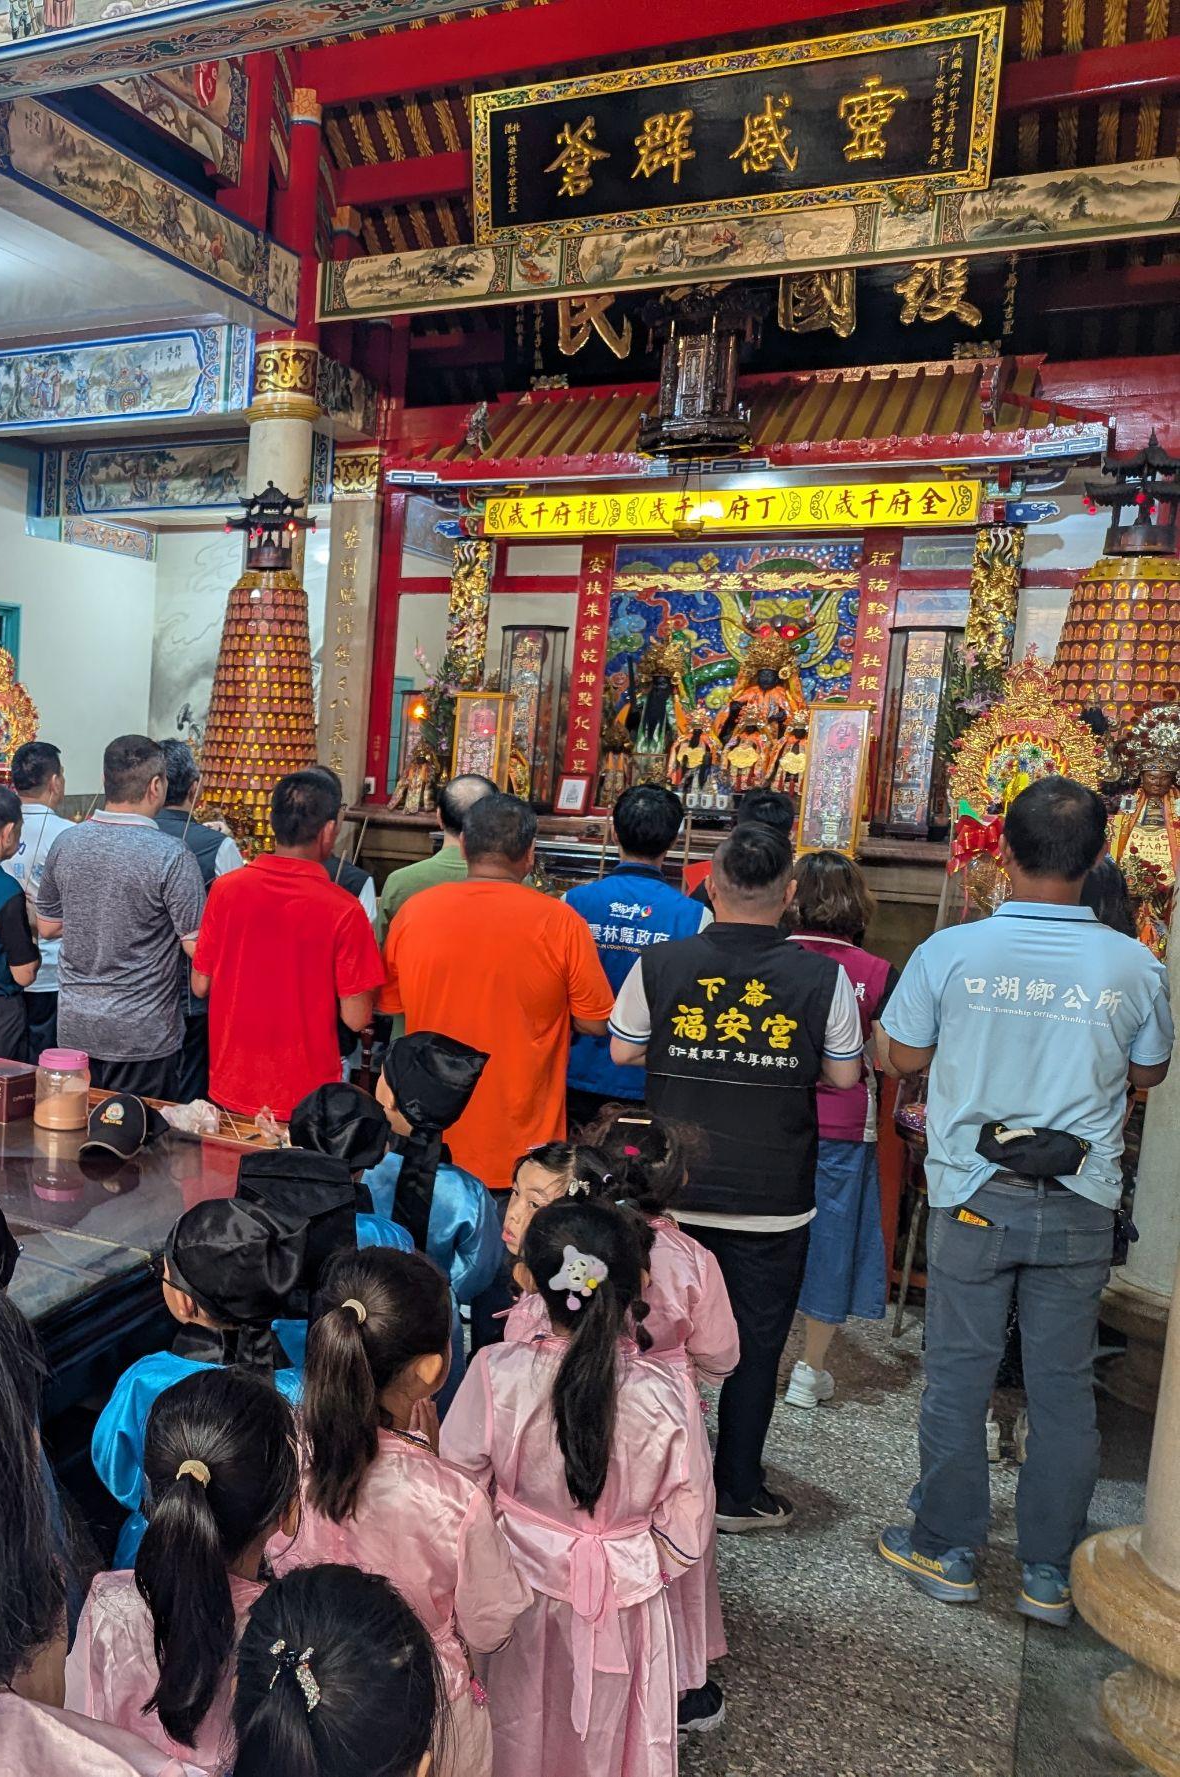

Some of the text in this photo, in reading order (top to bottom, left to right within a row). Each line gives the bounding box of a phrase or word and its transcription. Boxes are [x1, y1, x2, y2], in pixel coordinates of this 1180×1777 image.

[833, 486, 947, 519] 金府千歲
[697, 977, 773, 1008] 下崙
[964, 976, 1123, 1017] 口湖鄉公所
[671, 1004, 798, 1049] 福安宮
